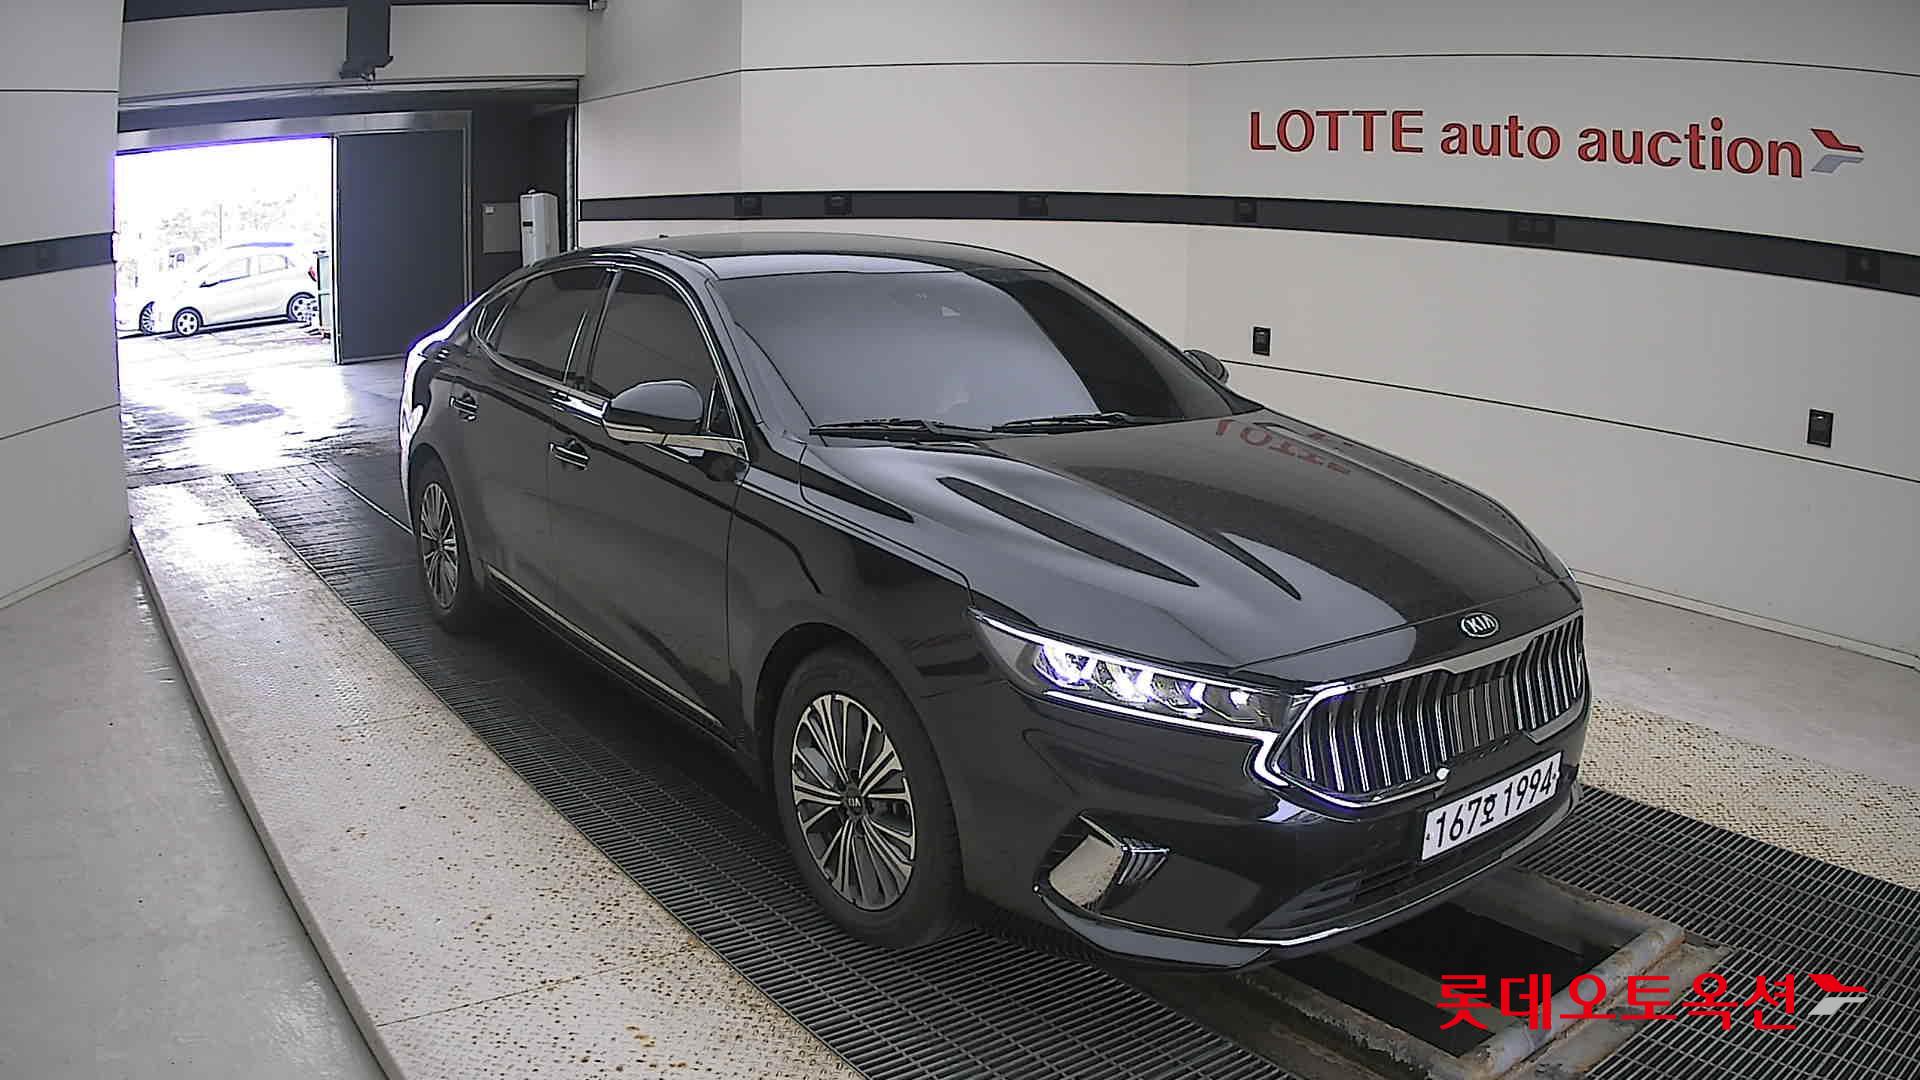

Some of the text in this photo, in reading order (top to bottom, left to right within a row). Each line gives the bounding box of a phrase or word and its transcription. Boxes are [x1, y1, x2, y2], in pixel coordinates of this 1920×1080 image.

[1249, 111, 1803, 178] LOTTE auto auction
[1466, 615, 1495, 633] KIA
[1436, 761, 1555, 848] 167호 1994
